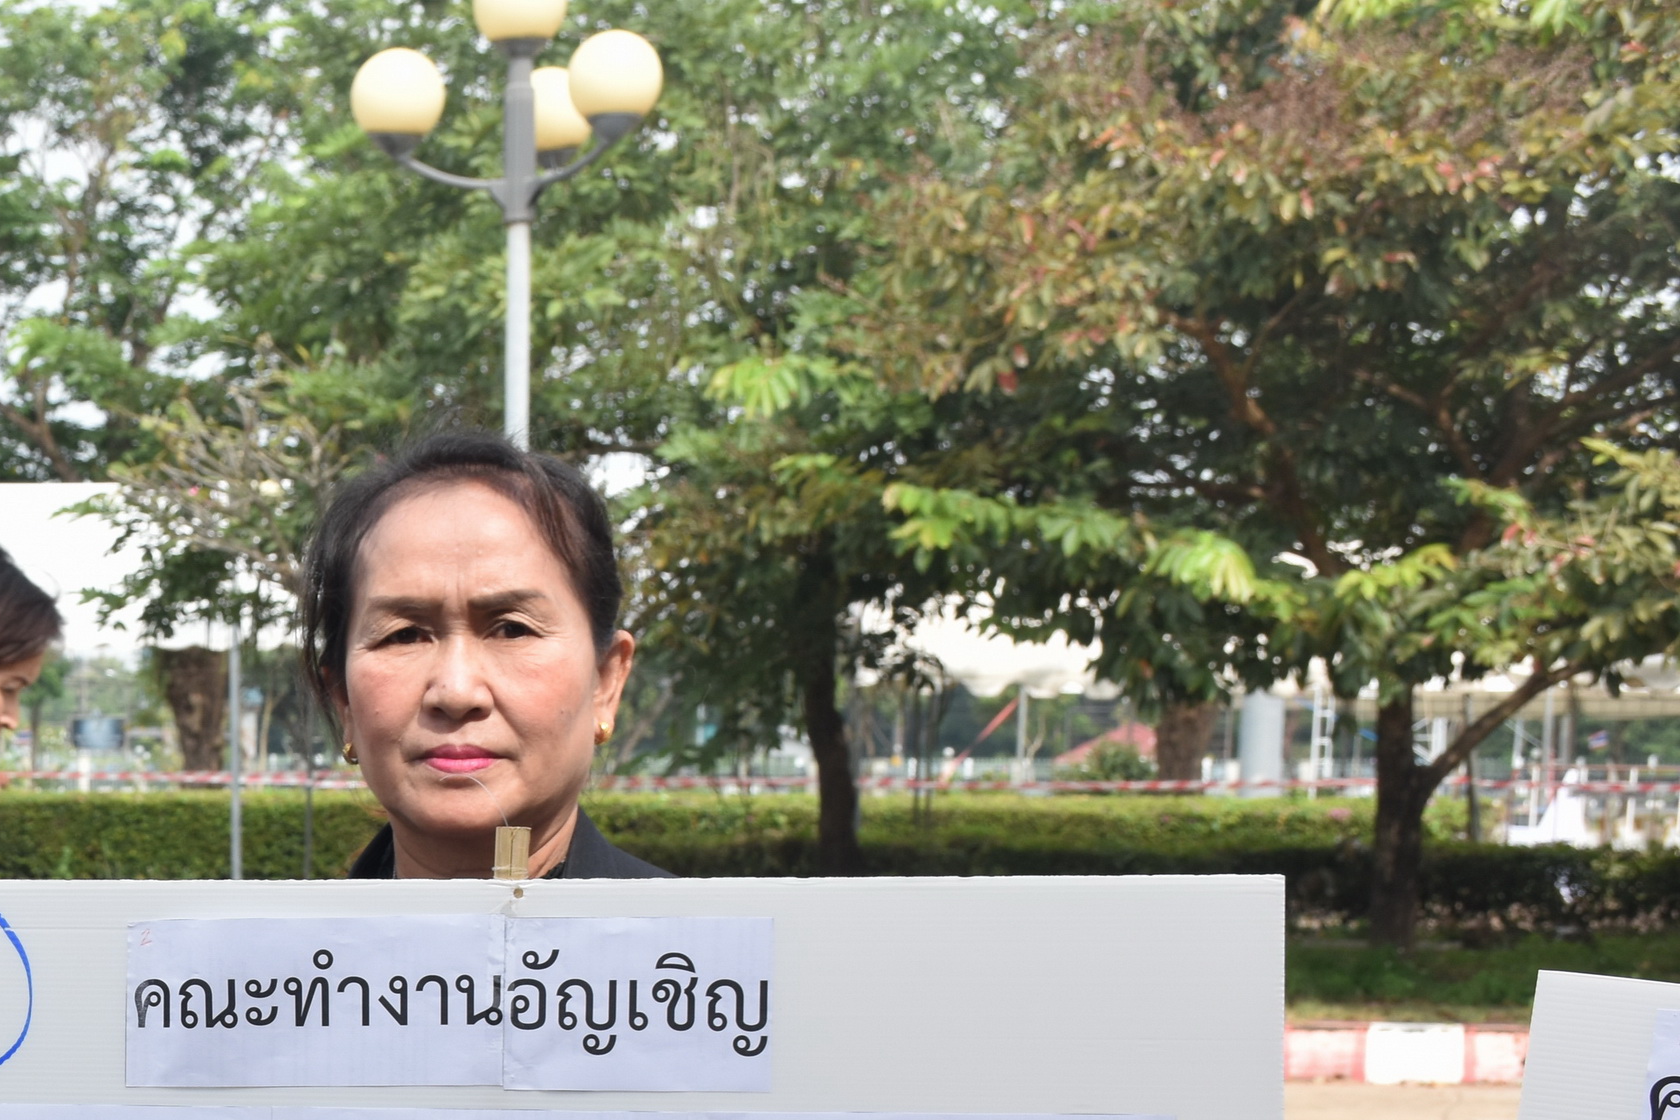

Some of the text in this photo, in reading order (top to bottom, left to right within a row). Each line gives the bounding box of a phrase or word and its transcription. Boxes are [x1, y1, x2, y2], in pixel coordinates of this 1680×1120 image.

[134, 949, 769, 1057] คณะทำงานอัญเชิญ
